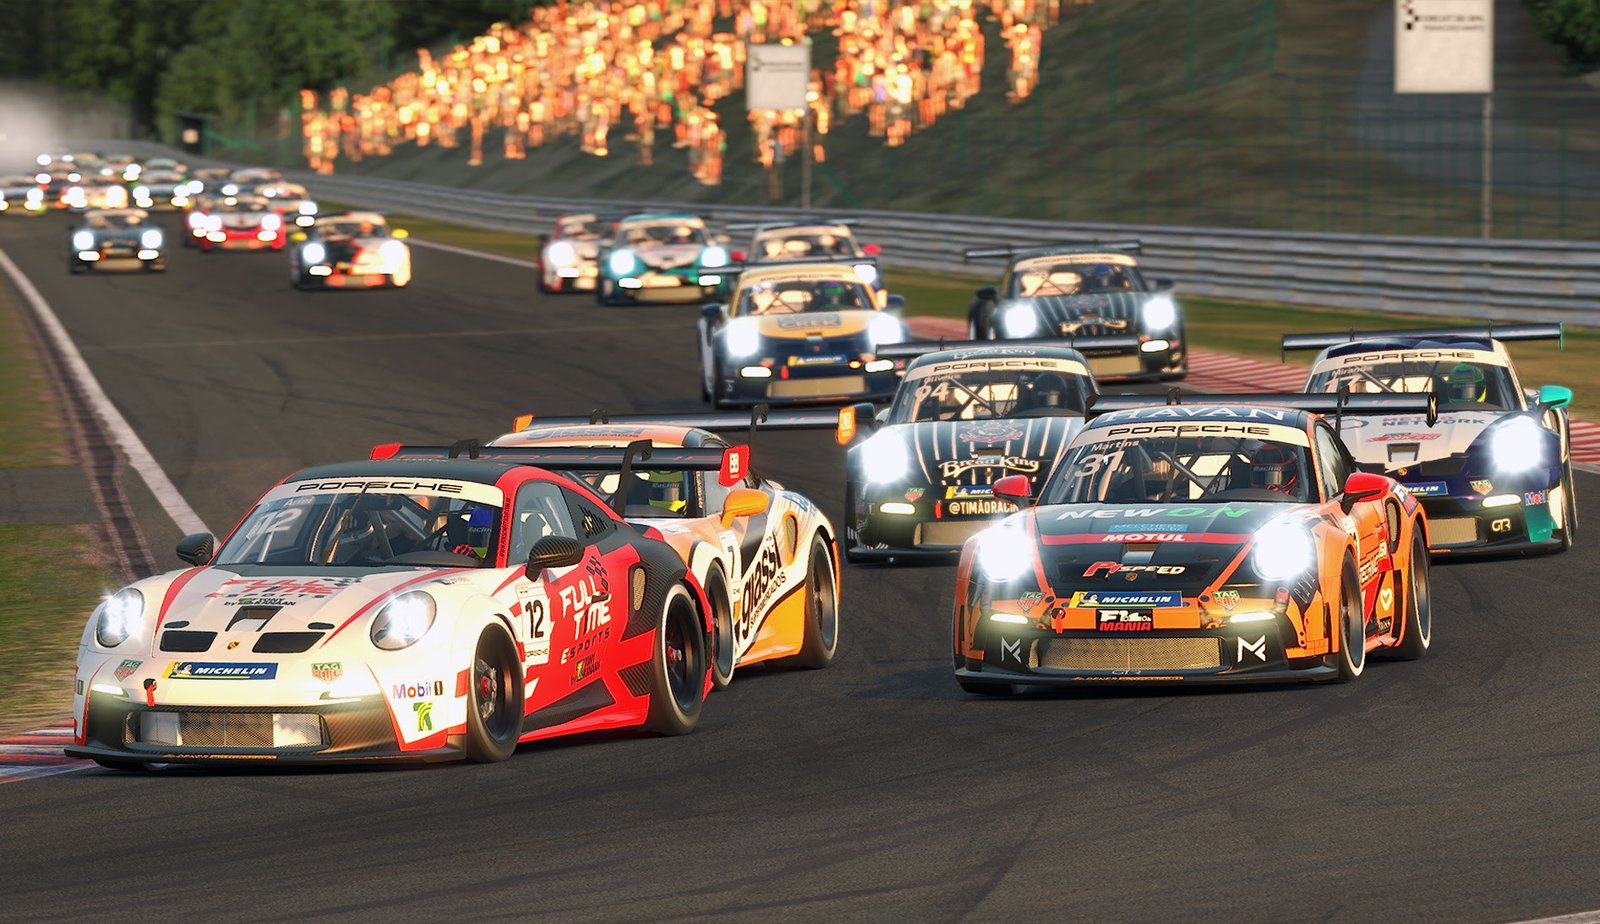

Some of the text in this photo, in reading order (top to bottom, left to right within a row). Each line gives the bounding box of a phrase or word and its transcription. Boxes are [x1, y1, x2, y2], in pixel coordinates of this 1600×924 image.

[1344, 352, 1474, 364] PORSCHE
[934, 361, 1057, 372] PORSCHE
[1108, 407, 1286, 422] HAVAN
[1108, 425, 1270, 437] PORSCHE
[1091, 439, 1139, 452] Martins
[938, 456, 1040, 479] Bread King
[1074, 450, 1126, 478] 31
[296, 481, 463, 493] PORSCHE
[1407, 485, 1439, 495] HELIN
[949, 501, 1019, 515] @TIMÃORACIN
[1492, 518, 1511, 532] GTR
[1101, 534, 1185, 542] MOTUL
[727, 545, 735, 579] 7
[559, 575, 600, 618] FULL
[1102, 596, 1172, 604] MICHELIN
[525, 600, 544, 638] 12
[1100, 622, 1151, 632] MANIA
[393, 683, 431, 698] Mobil
